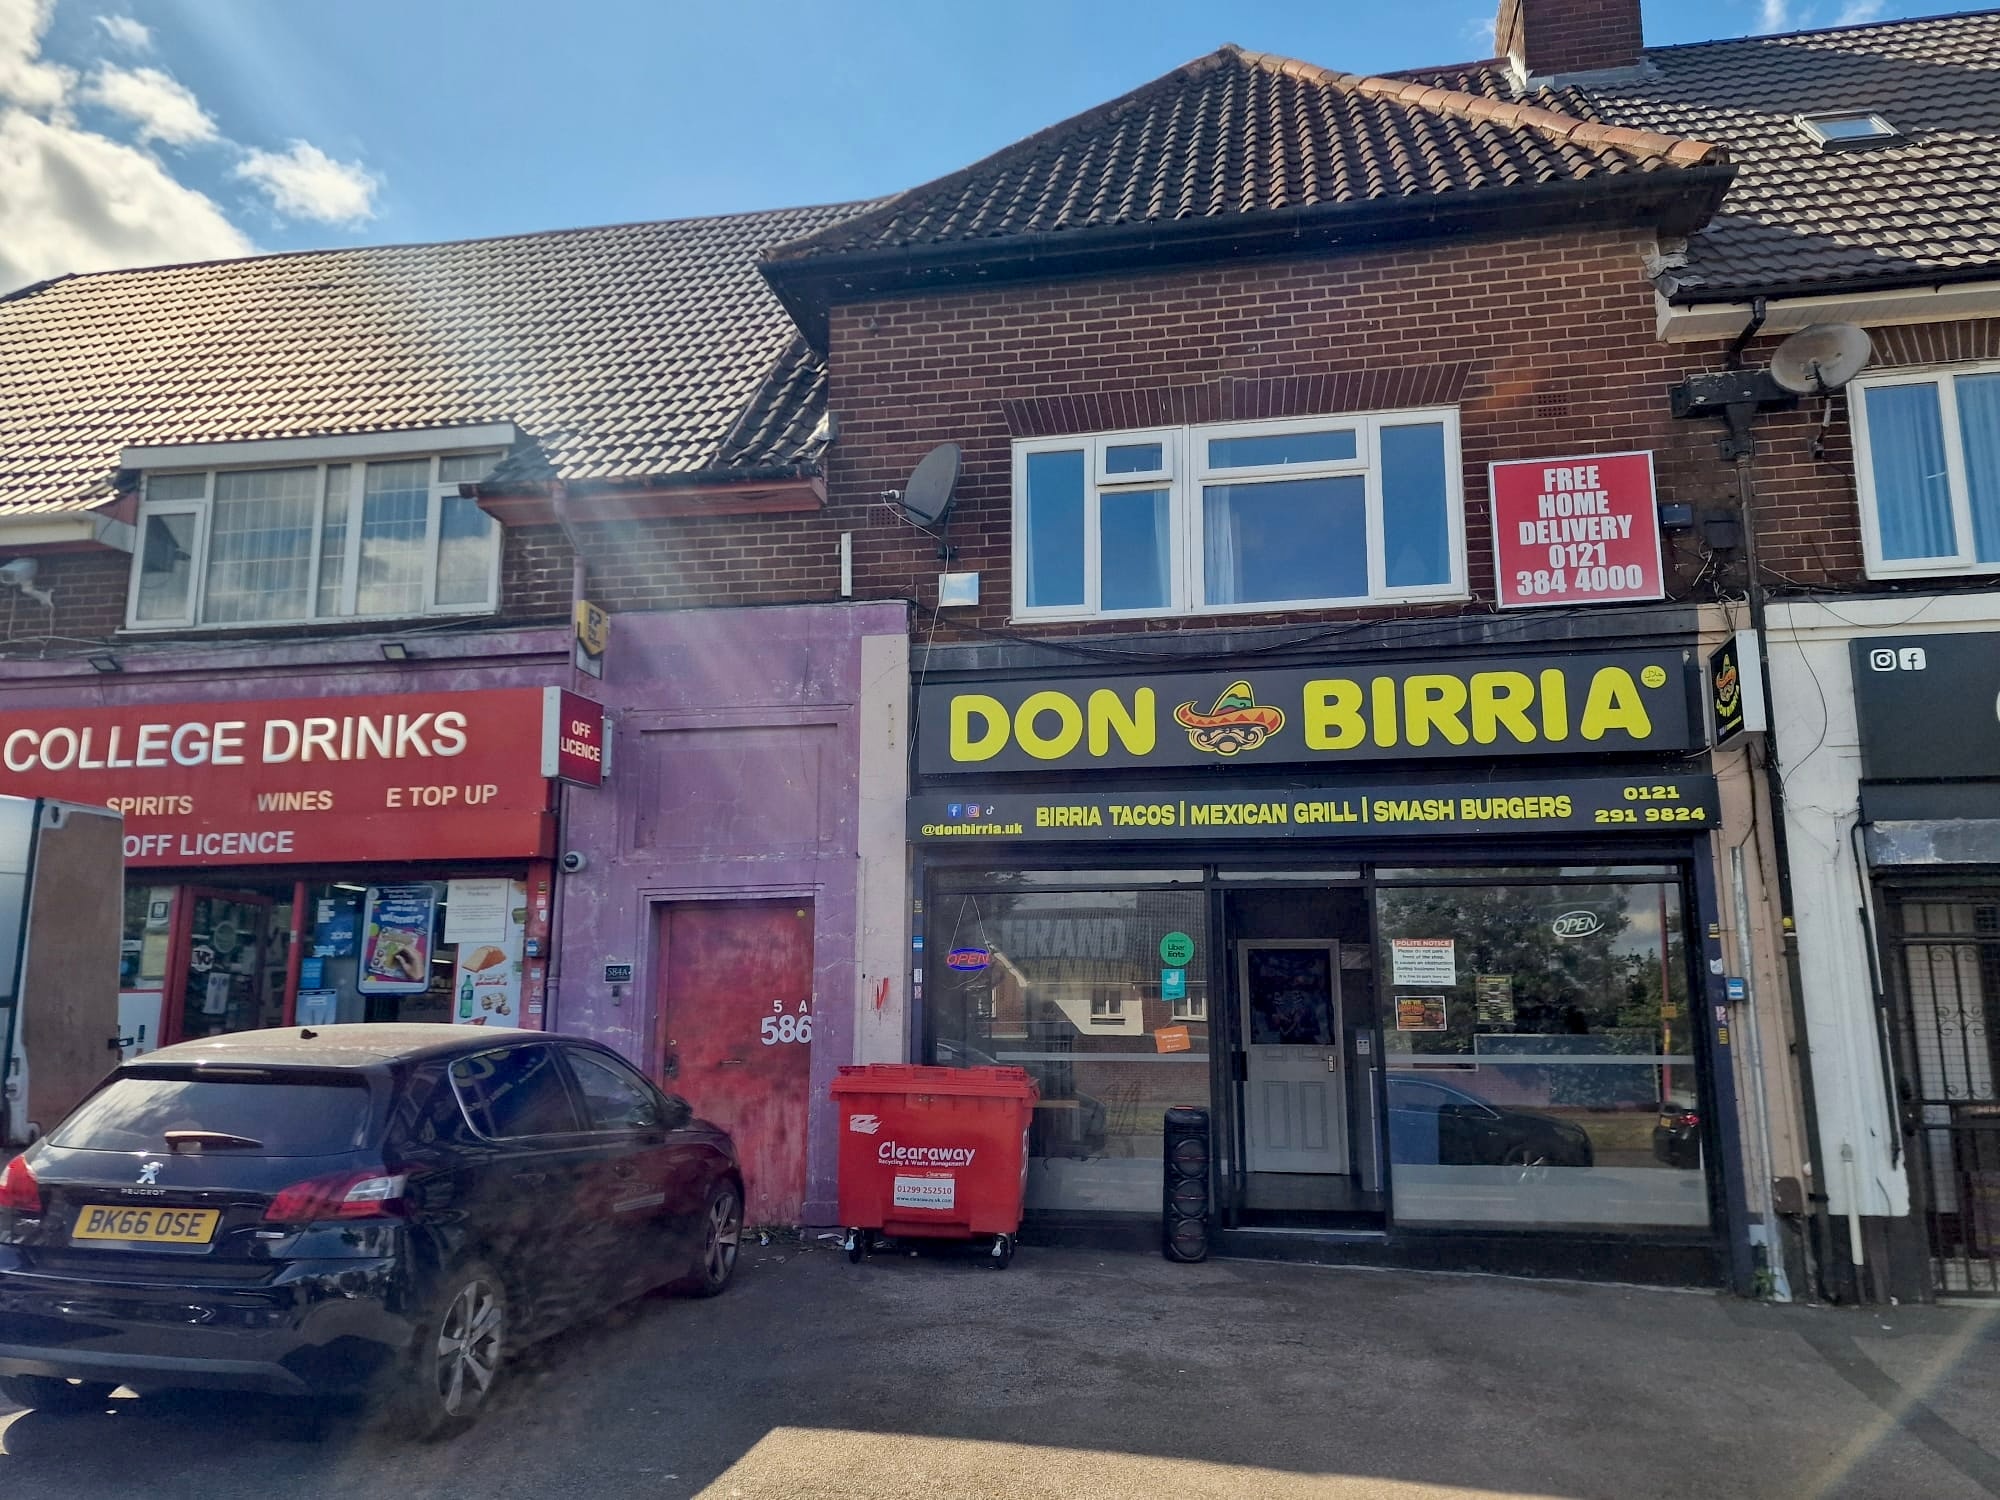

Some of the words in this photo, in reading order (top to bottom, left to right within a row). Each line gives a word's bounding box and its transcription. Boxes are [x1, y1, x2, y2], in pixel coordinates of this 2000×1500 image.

[1543, 465, 1600, 492] FREE
[1538, 490, 1610, 519] HOME
[1518, 514, 1633, 546] DELIVERY
[1549, 541, 1607, 569] 0121
[1516, 569, 1567, 596] 384
[1574, 564, 1643, 592] 4000
[950, 686, 1156, 762] DON
[1303, 666, 1652, 751] BIRRIA
[3, 720, 246, 772] COLLEGE
[262, 710, 468, 764] DRINKS
[571, 719, 592, 739] OFF
[560, 736, 601, 762] LICENCE
[106, 795, 193, 816] SPIRITS
[257, 790, 334, 812] WINES
[386, 787, 402, 808] E
[408, 785, 458, 807] TOP
[464, 784, 498, 805] UP
[1623, 785, 1680, 801] 0121
[1036, 805, 1102, 827] BIRRIA
[1108, 804, 1175, 827] TACOS
[1191, 803, 1288, 826] MEXICAN
[1293, 801, 1358, 824] GRILL
[1373, 799, 1455, 822] SMASH
[1461, 795, 1573, 821] BURGERS
[1594, 808, 1638, 823] 291
[1645, 806, 1706, 823] 9824
[921, 822, 1023, 837] @donbirria.uk
[123, 834, 173, 857] OFF
[180, 831, 295, 856] LICENCE
[1554, 917, 1597, 934] OPEN
[946, 953, 990, 966] OPEN
[1167, 943, 1185, 951] Uber
[773, 999, 783, 1013] 5
[798, 999, 808, 1013] A
[761, 1014, 812, 1045] 586
[878, 1140, 976, 1166] Clearaway
[878, 1158, 903, 1166] Recycling
[121, 1188, 167, 1196] PEUGEOT
[897, 1185, 921, 1193] 01299
[923, 1186, 952, 1195] 252510
[86, 1209, 151, 1235] BK66
[155, 1212, 206, 1237] OSE
